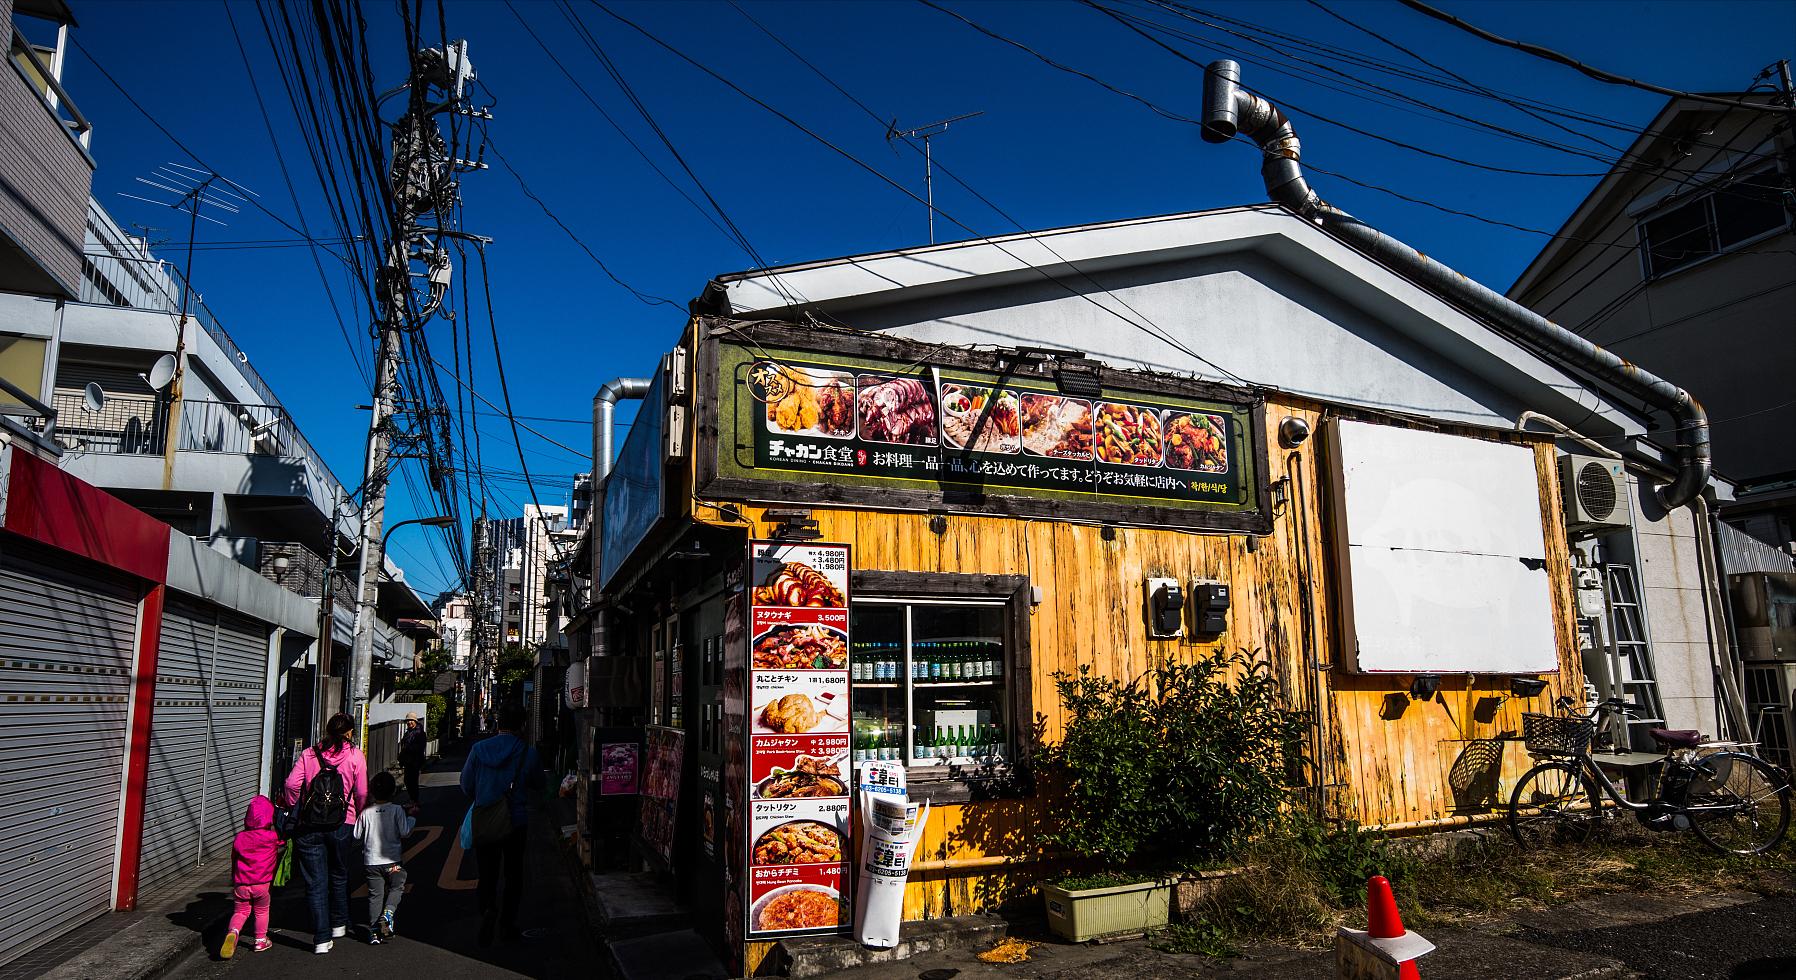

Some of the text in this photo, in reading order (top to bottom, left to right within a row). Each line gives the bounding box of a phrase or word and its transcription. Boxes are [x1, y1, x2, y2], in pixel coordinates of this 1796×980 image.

[769, 440, 854, 463] チャカン食堂
[757, 611, 792, 620] ヌタウナギ
[756, 739, 799, 747] カムジャタン
[756, 803, 797, 812] タットリタン
[818, 804, 848, 812] 2,880円
[755, 868, 799, 878] おからチヂミ
